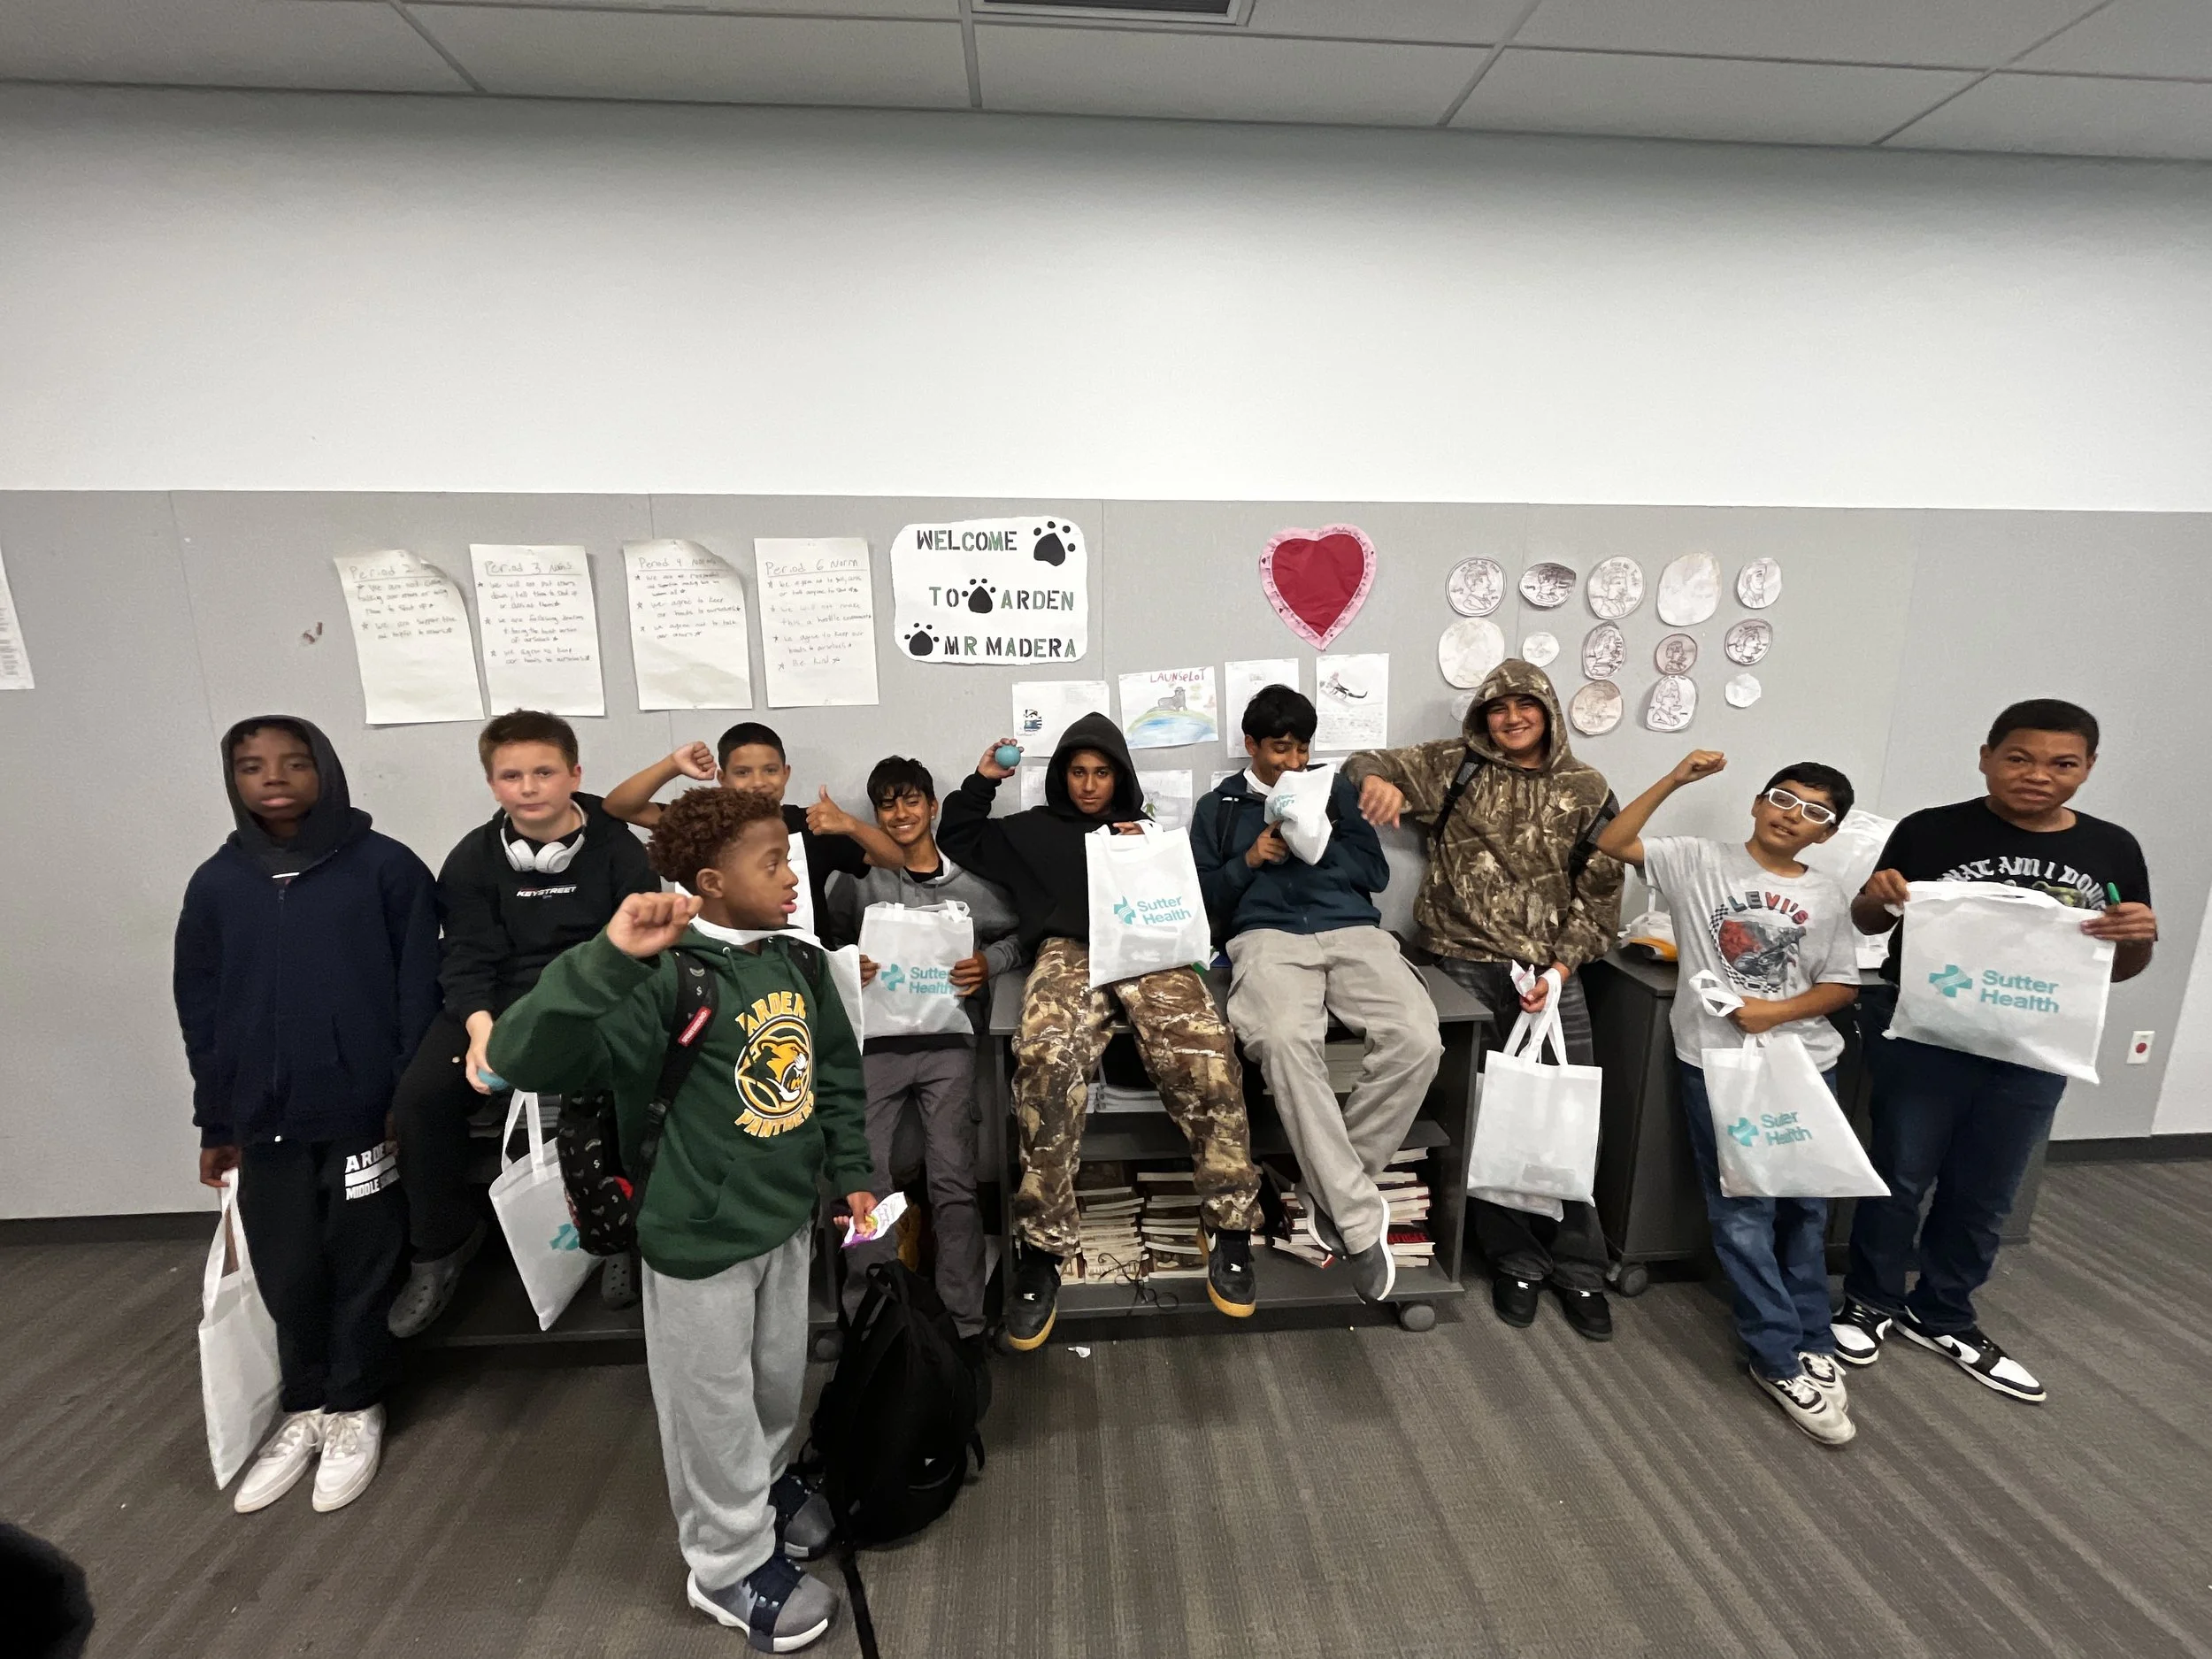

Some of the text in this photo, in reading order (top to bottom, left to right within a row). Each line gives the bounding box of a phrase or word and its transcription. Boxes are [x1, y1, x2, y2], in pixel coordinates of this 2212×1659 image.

[918, 530, 1018, 551] WELCOME
[349, 564, 414, 580] Period 2
[484, 561, 523, 573] Period
[531, 563, 541, 574] 3
[638, 557, 669, 569] Period
[765, 559, 858, 575] Period 6 Norm
[929, 587, 1073, 611] TO ARDEN
[944, 636, 1076, 657] MR MADERA
[1999, 856, 2039, 877] AM
[2044, 861, 2056, 879] I
[517, 886, 577, 897] KEYSTREET
[1137, 895, 1183, 912] Sutter
[1727, 890, 1809, 925] LEVI'S
[1142, 908, 1192, 926] Health
[910, 966, 949, 979] Sutte
[1981, 969, 2060, 995] Sutter
[1979, 987, 2060, 1013] Health
[345, 1179, 380, 1201] MIDDLE
